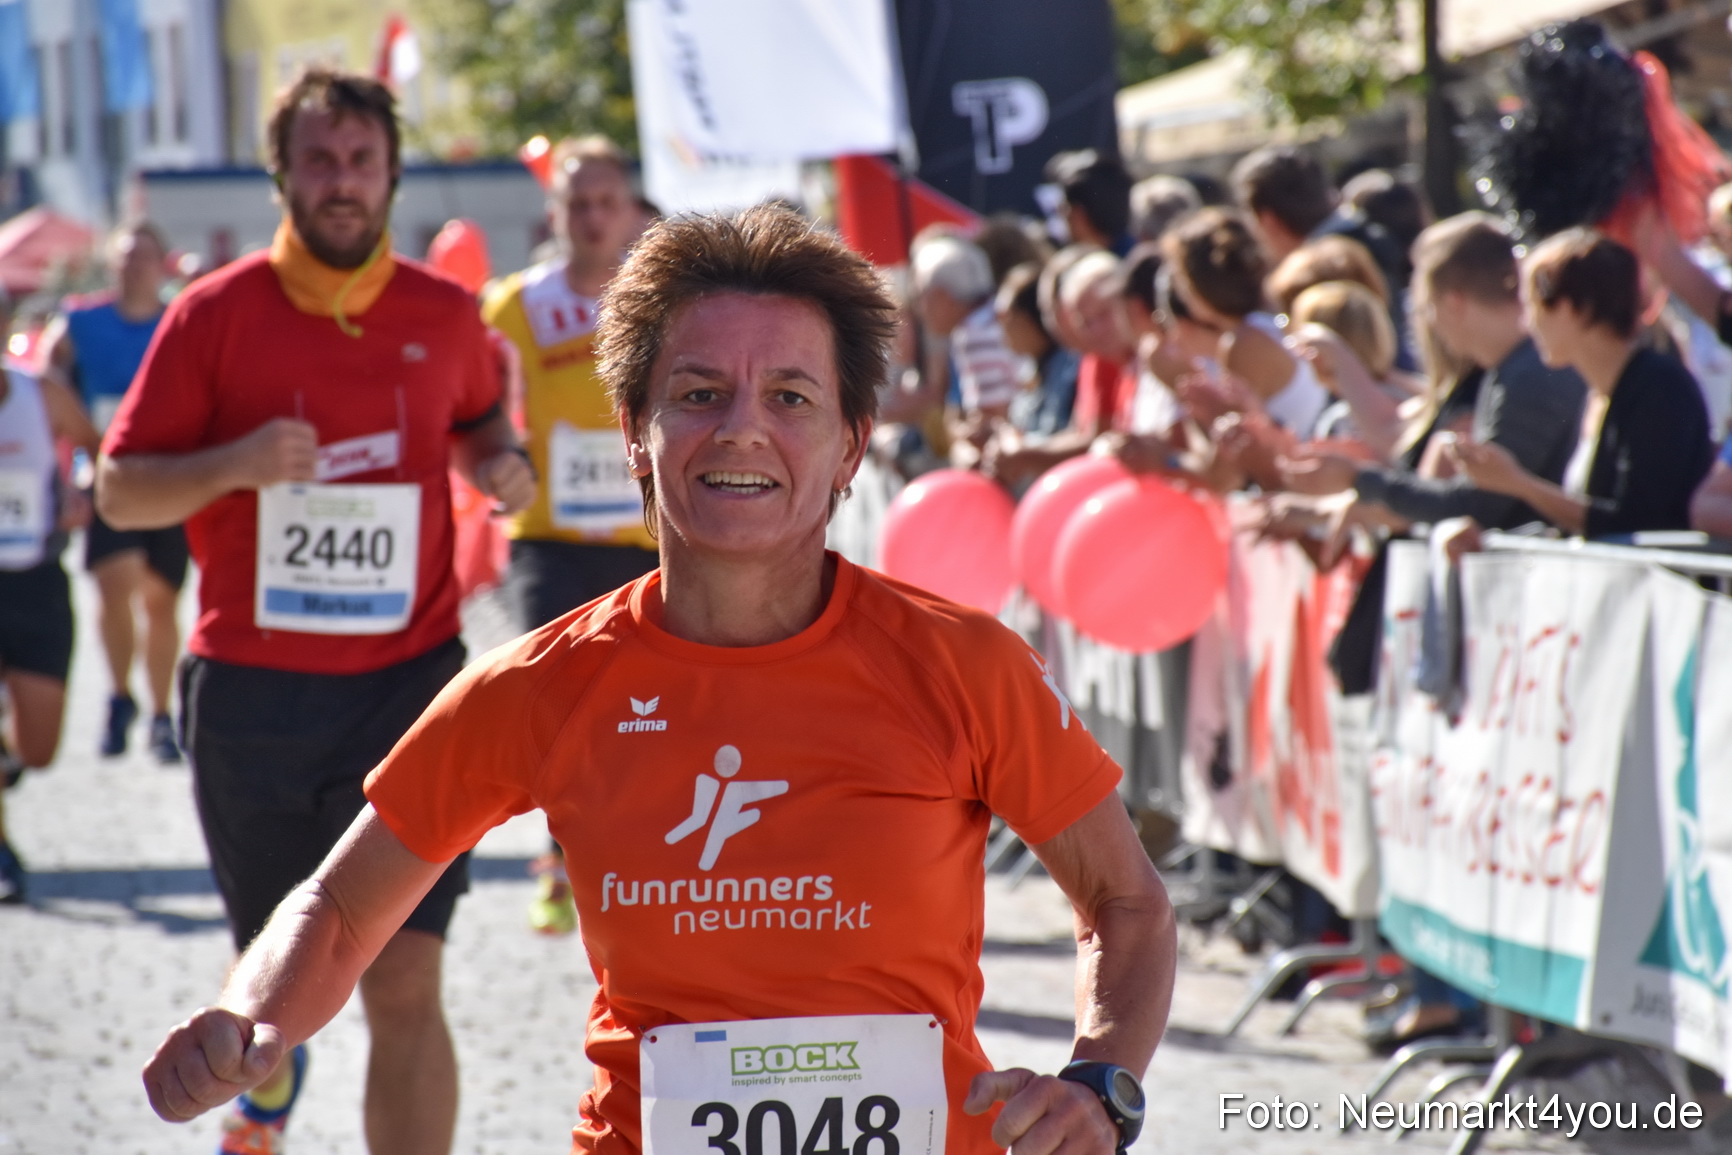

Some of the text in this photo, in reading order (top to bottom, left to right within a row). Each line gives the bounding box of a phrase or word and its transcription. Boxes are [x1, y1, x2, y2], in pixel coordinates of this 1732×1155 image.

[284, 523, 395, 570] 2440
[617, 718, 668, 733] erima
[601, 872, 834, 913] funrunners
[674, 901, 872, 935] neumarkt
[730, 1041, 861, 1076] BOCK
[731, 1071, 862, 1087] inspired by smart concepts
[690, 1095, 902, 1155] 3048
